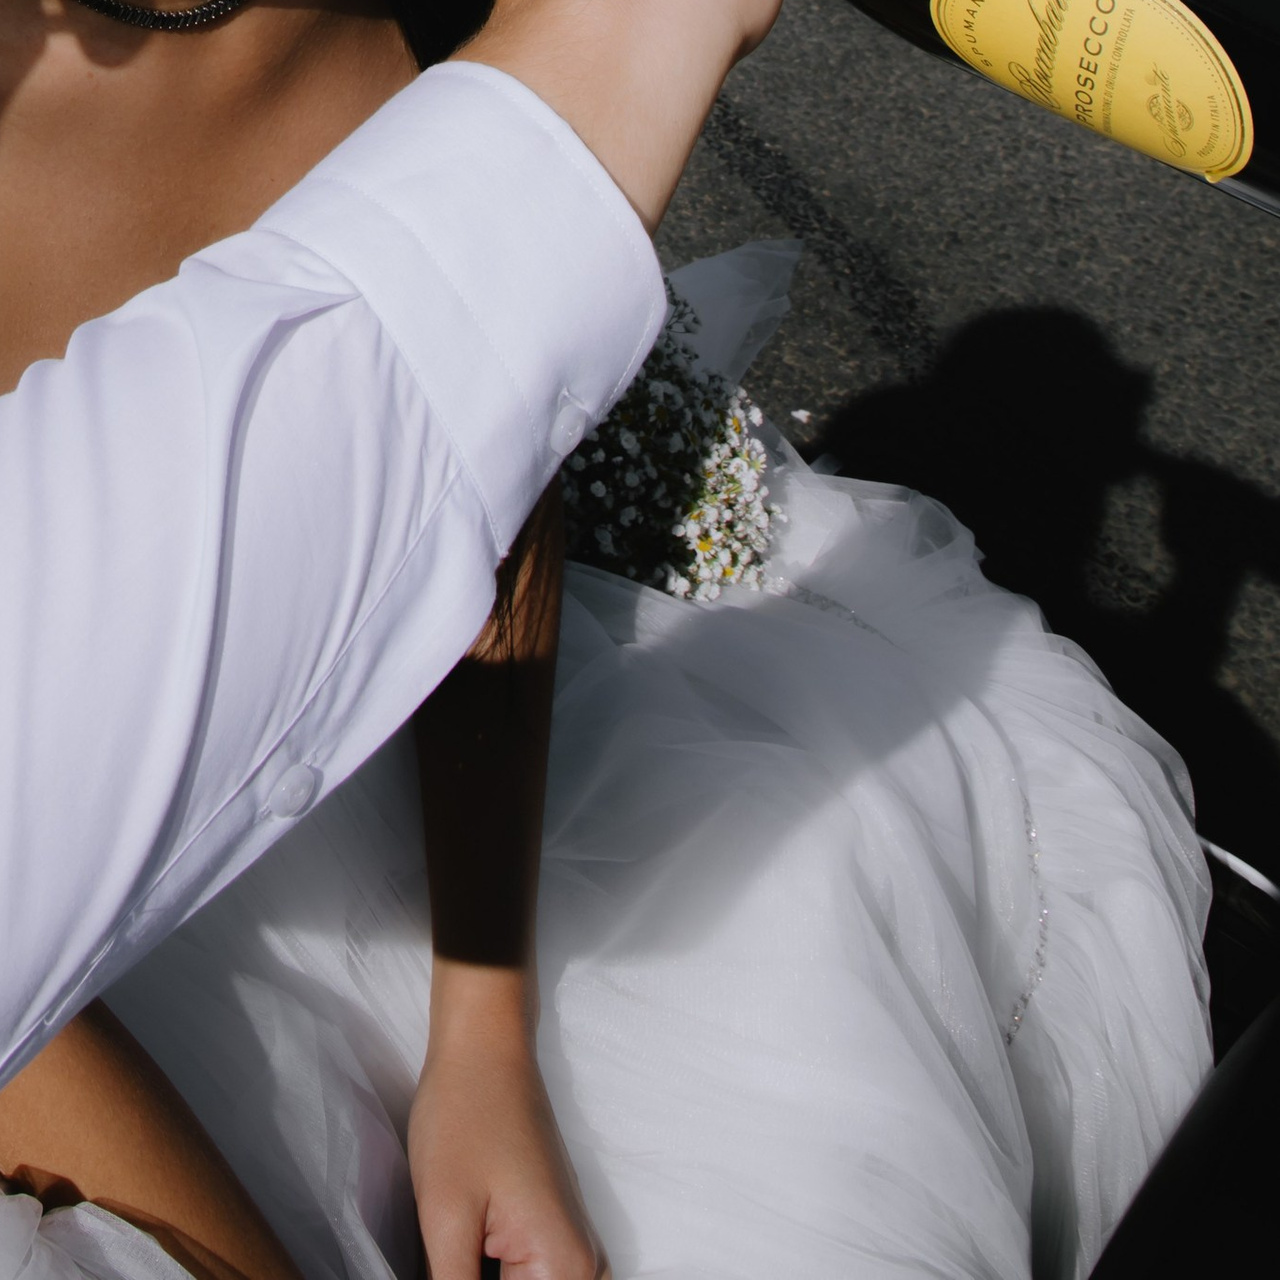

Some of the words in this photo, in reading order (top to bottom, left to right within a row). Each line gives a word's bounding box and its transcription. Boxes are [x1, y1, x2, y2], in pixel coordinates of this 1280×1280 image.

[1111, 7, 1135, 62] CONTROLLATA
[1105, 61, 1120, 90] ORIGINE
[1102, 100, 1113, 135] NAZIONE
[1153, 62, 1187, 157] Spumante
[1207, 95, 1220, 121] ITALIA
[1212, 123, 1220, 131] IN
[1197, 131, 1219, 157] PRODOTTO
